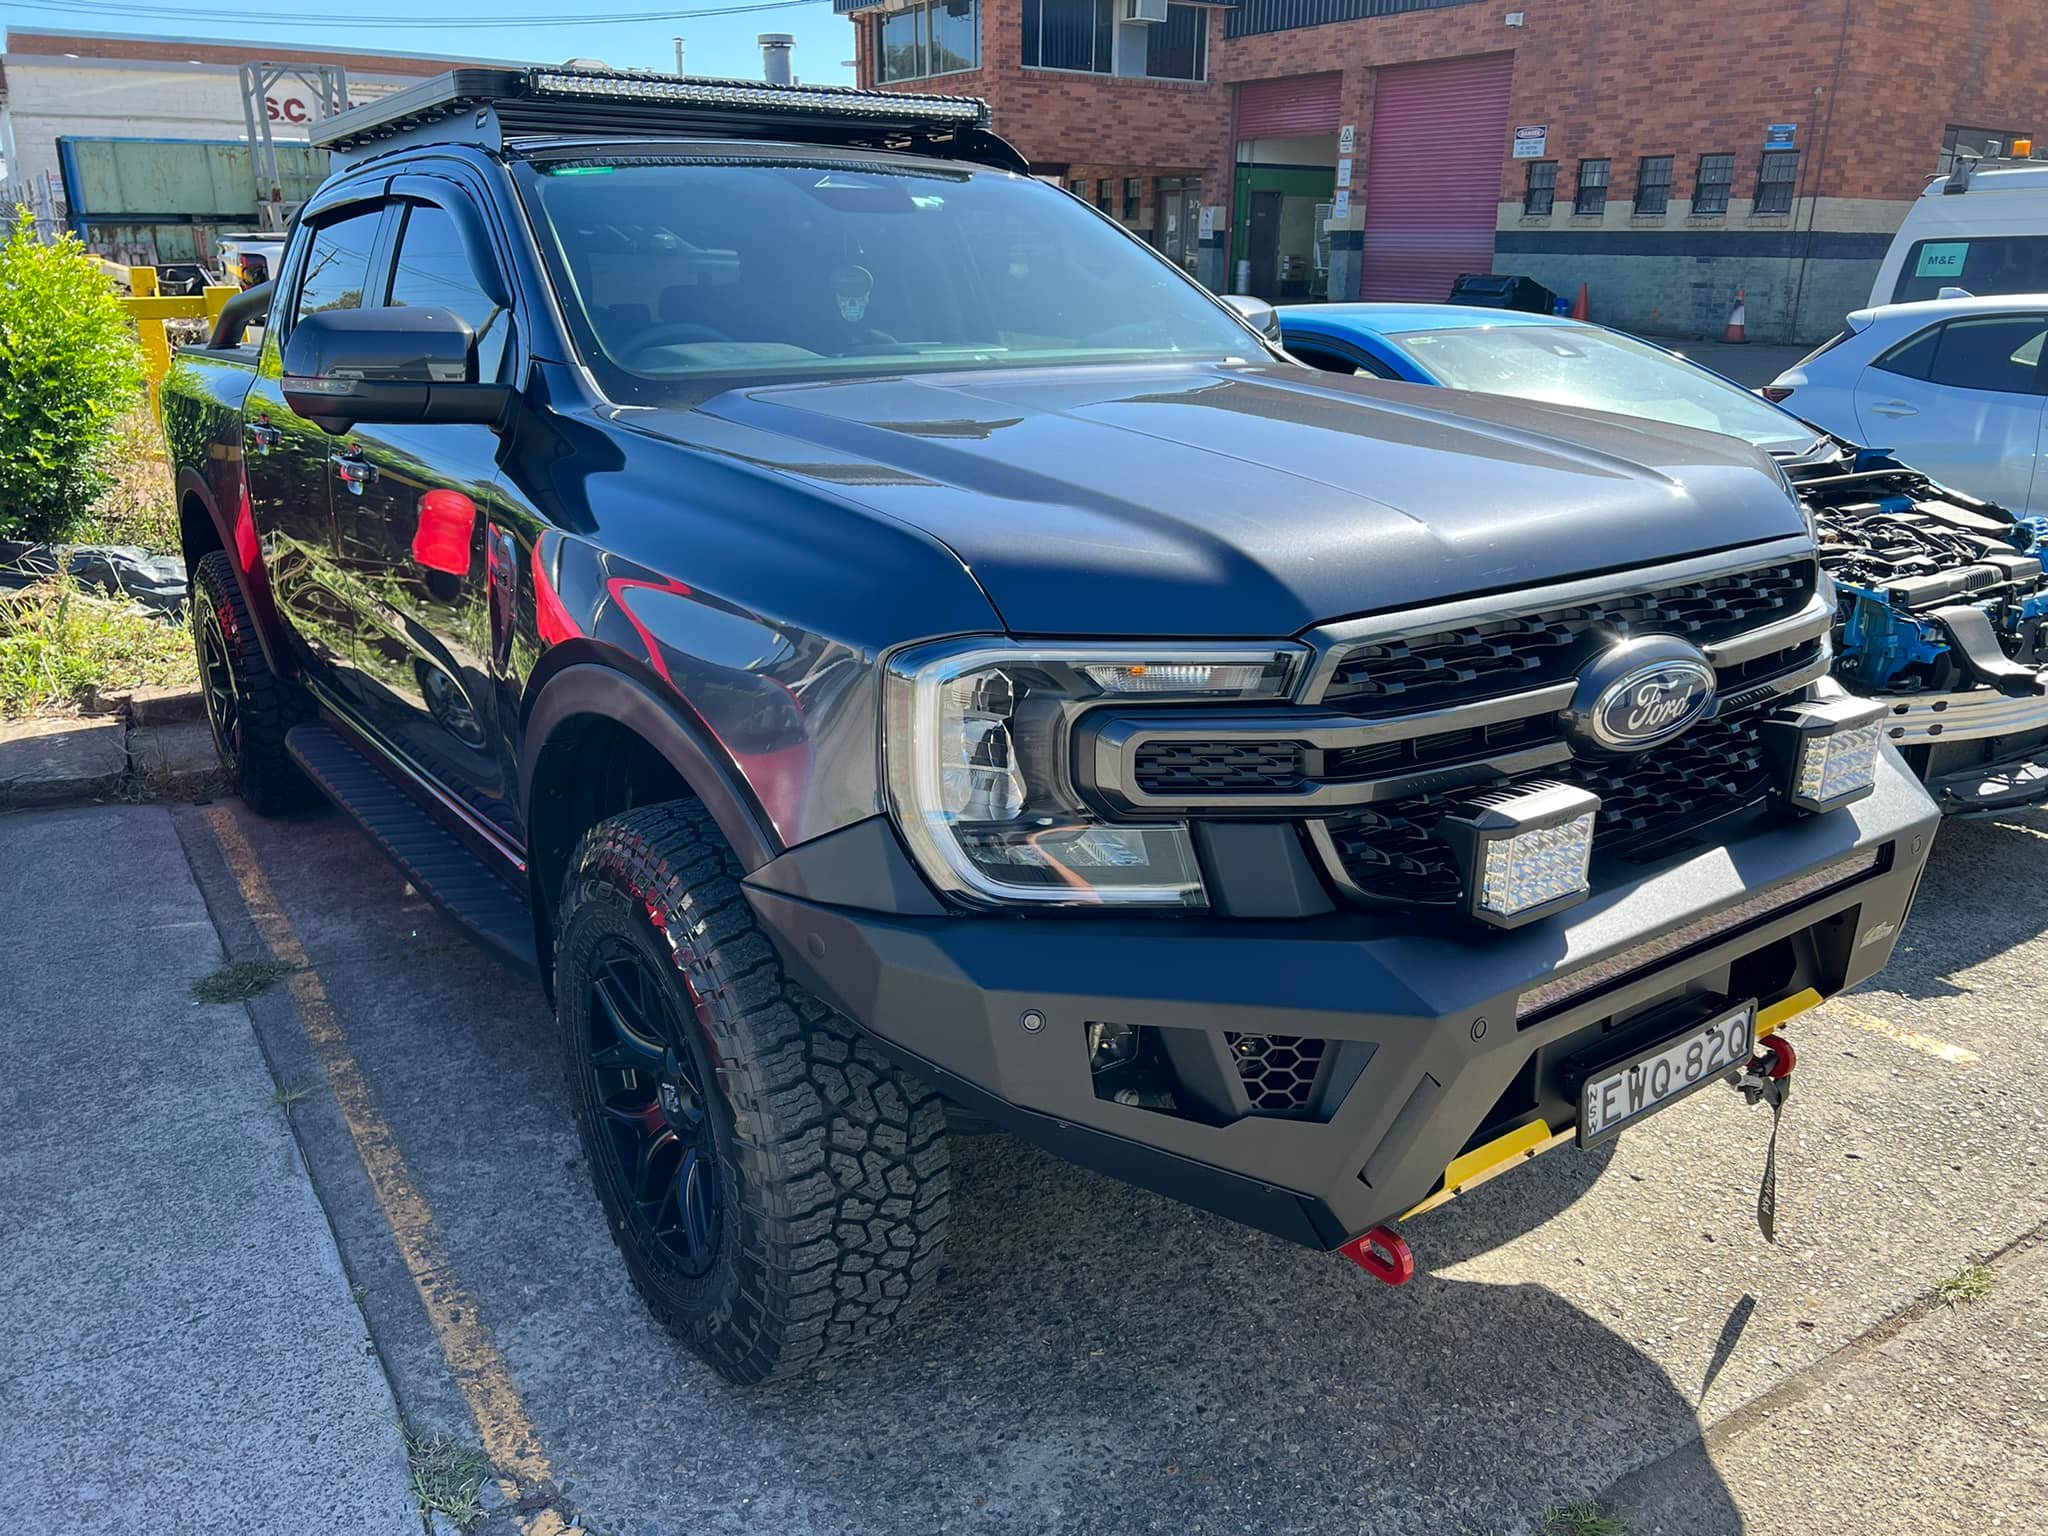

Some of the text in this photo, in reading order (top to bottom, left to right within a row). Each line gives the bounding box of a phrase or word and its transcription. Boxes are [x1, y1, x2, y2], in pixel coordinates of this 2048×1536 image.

[1927, 255, 1956, 265] M&E
[1627, 679, 1694, 731] Ford
[1588, 1088, 1598, 1138] NSW
